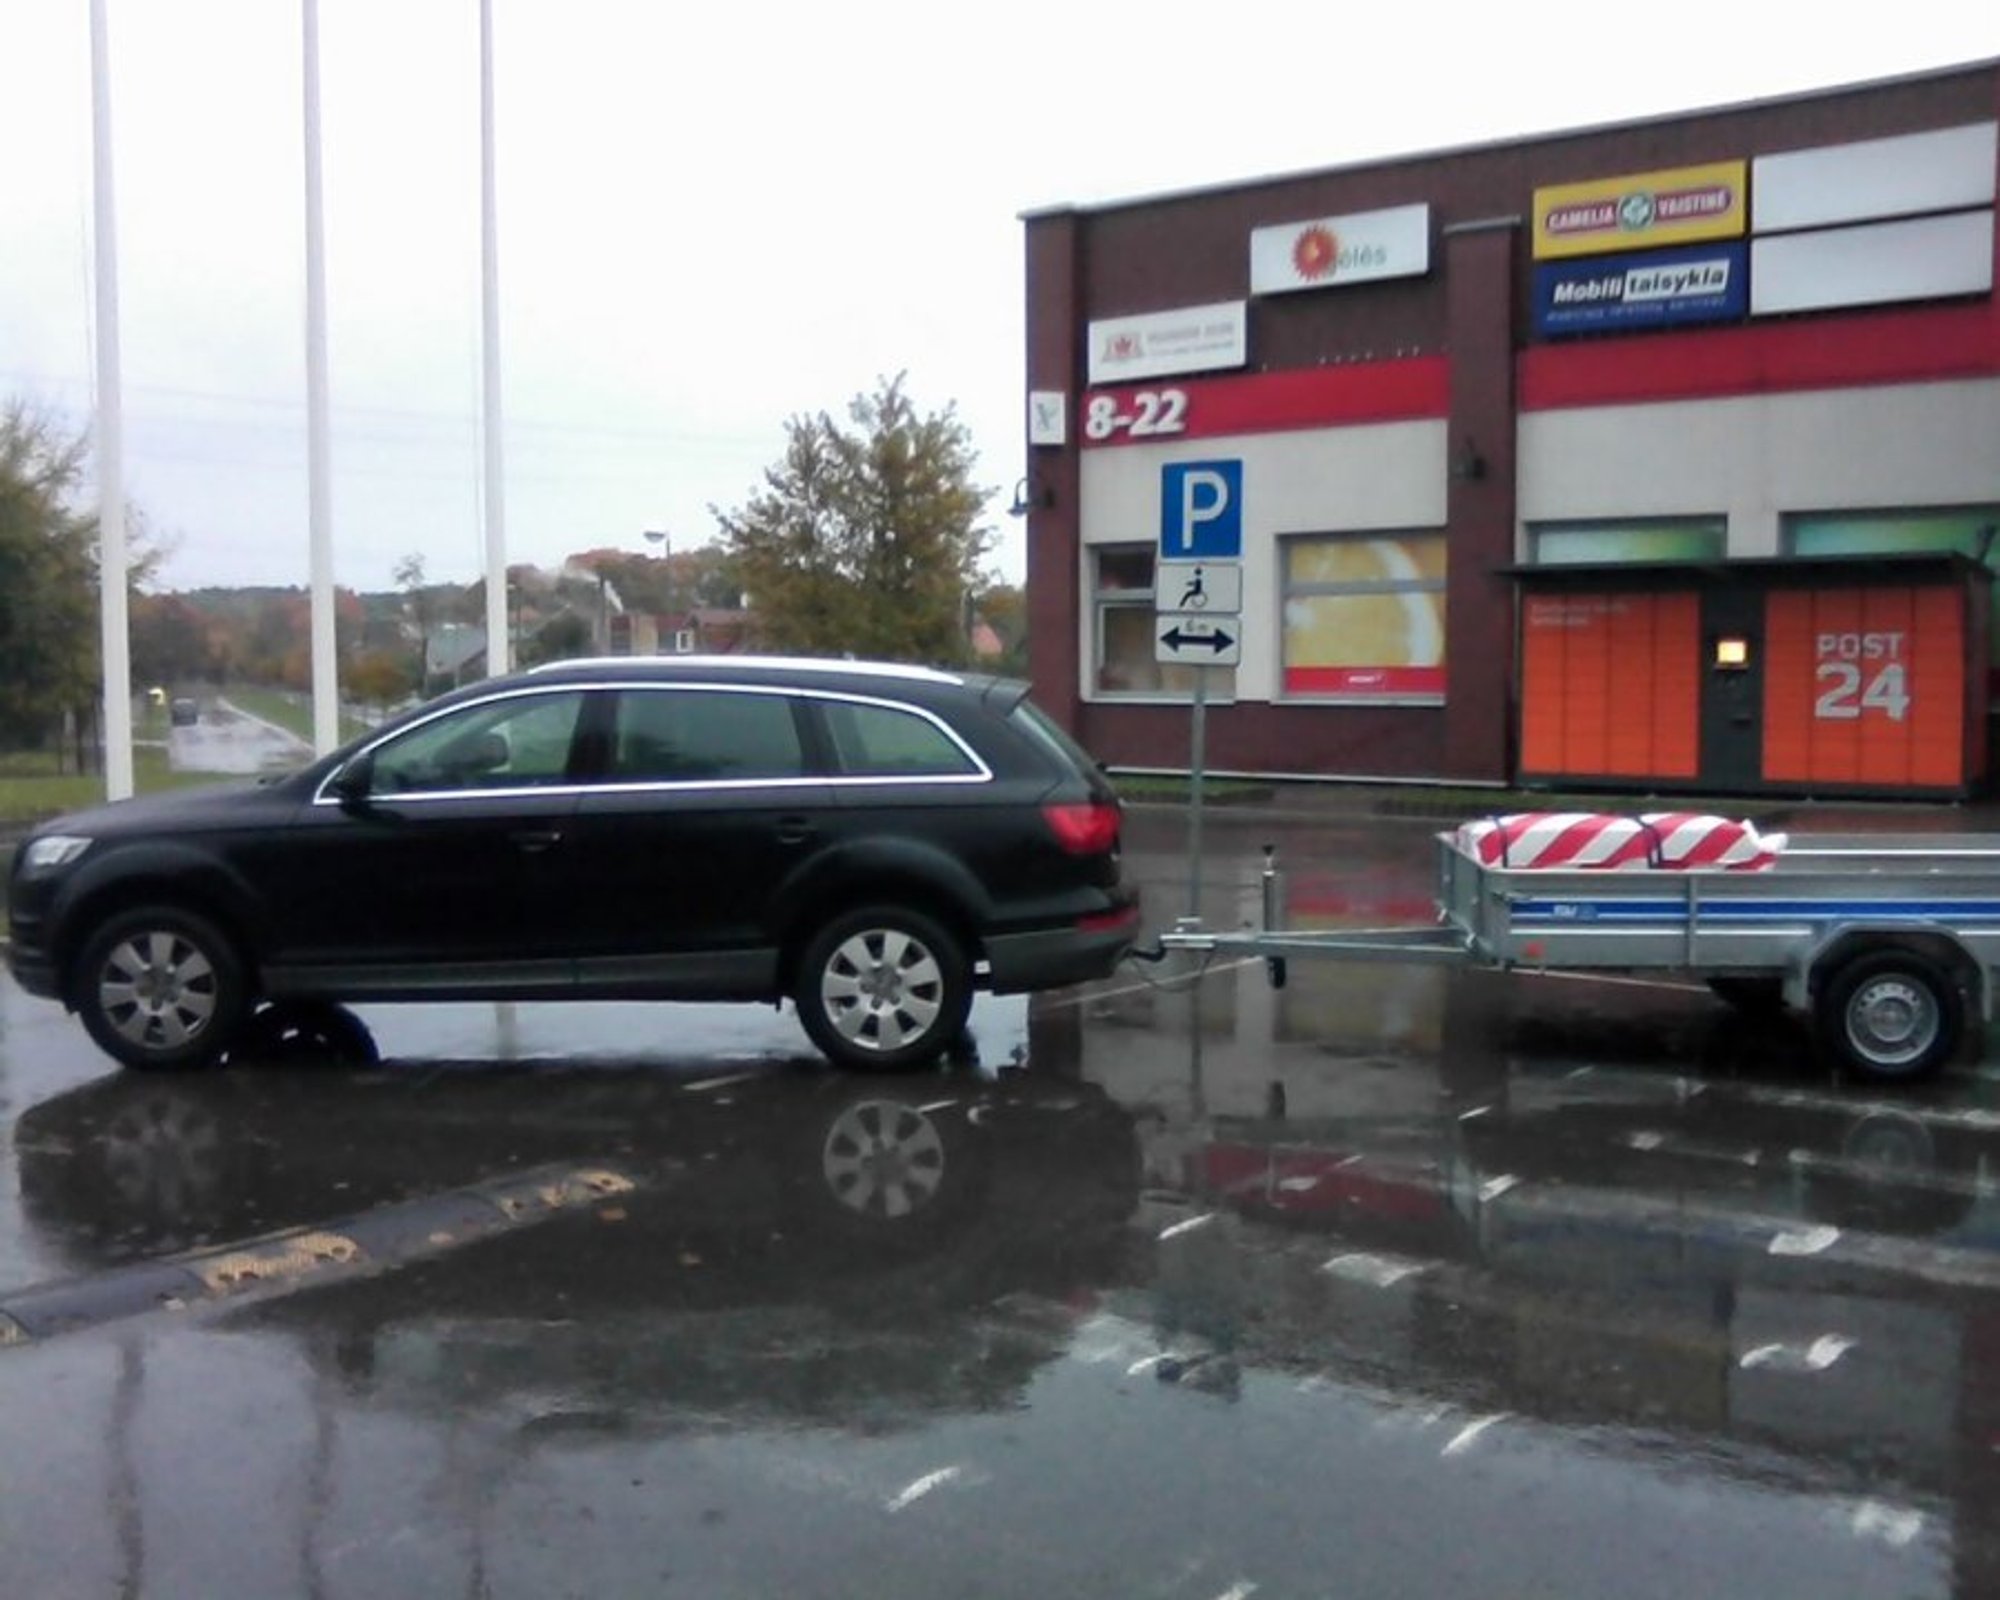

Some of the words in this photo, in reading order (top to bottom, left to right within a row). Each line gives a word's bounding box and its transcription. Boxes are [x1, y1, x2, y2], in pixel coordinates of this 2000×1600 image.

[1550, 205, 1614, 229] CAMELIA
[1554, 277, 1624, 303] Mobili
[1630, 267, 1724, 294] taisykla
[1086, 389, 1187, 439] 8-22
[1182, 470, 1228, 549] P
[1817, 632, 1904, 659] POST
[1814, 661, 1909, 721] 24
